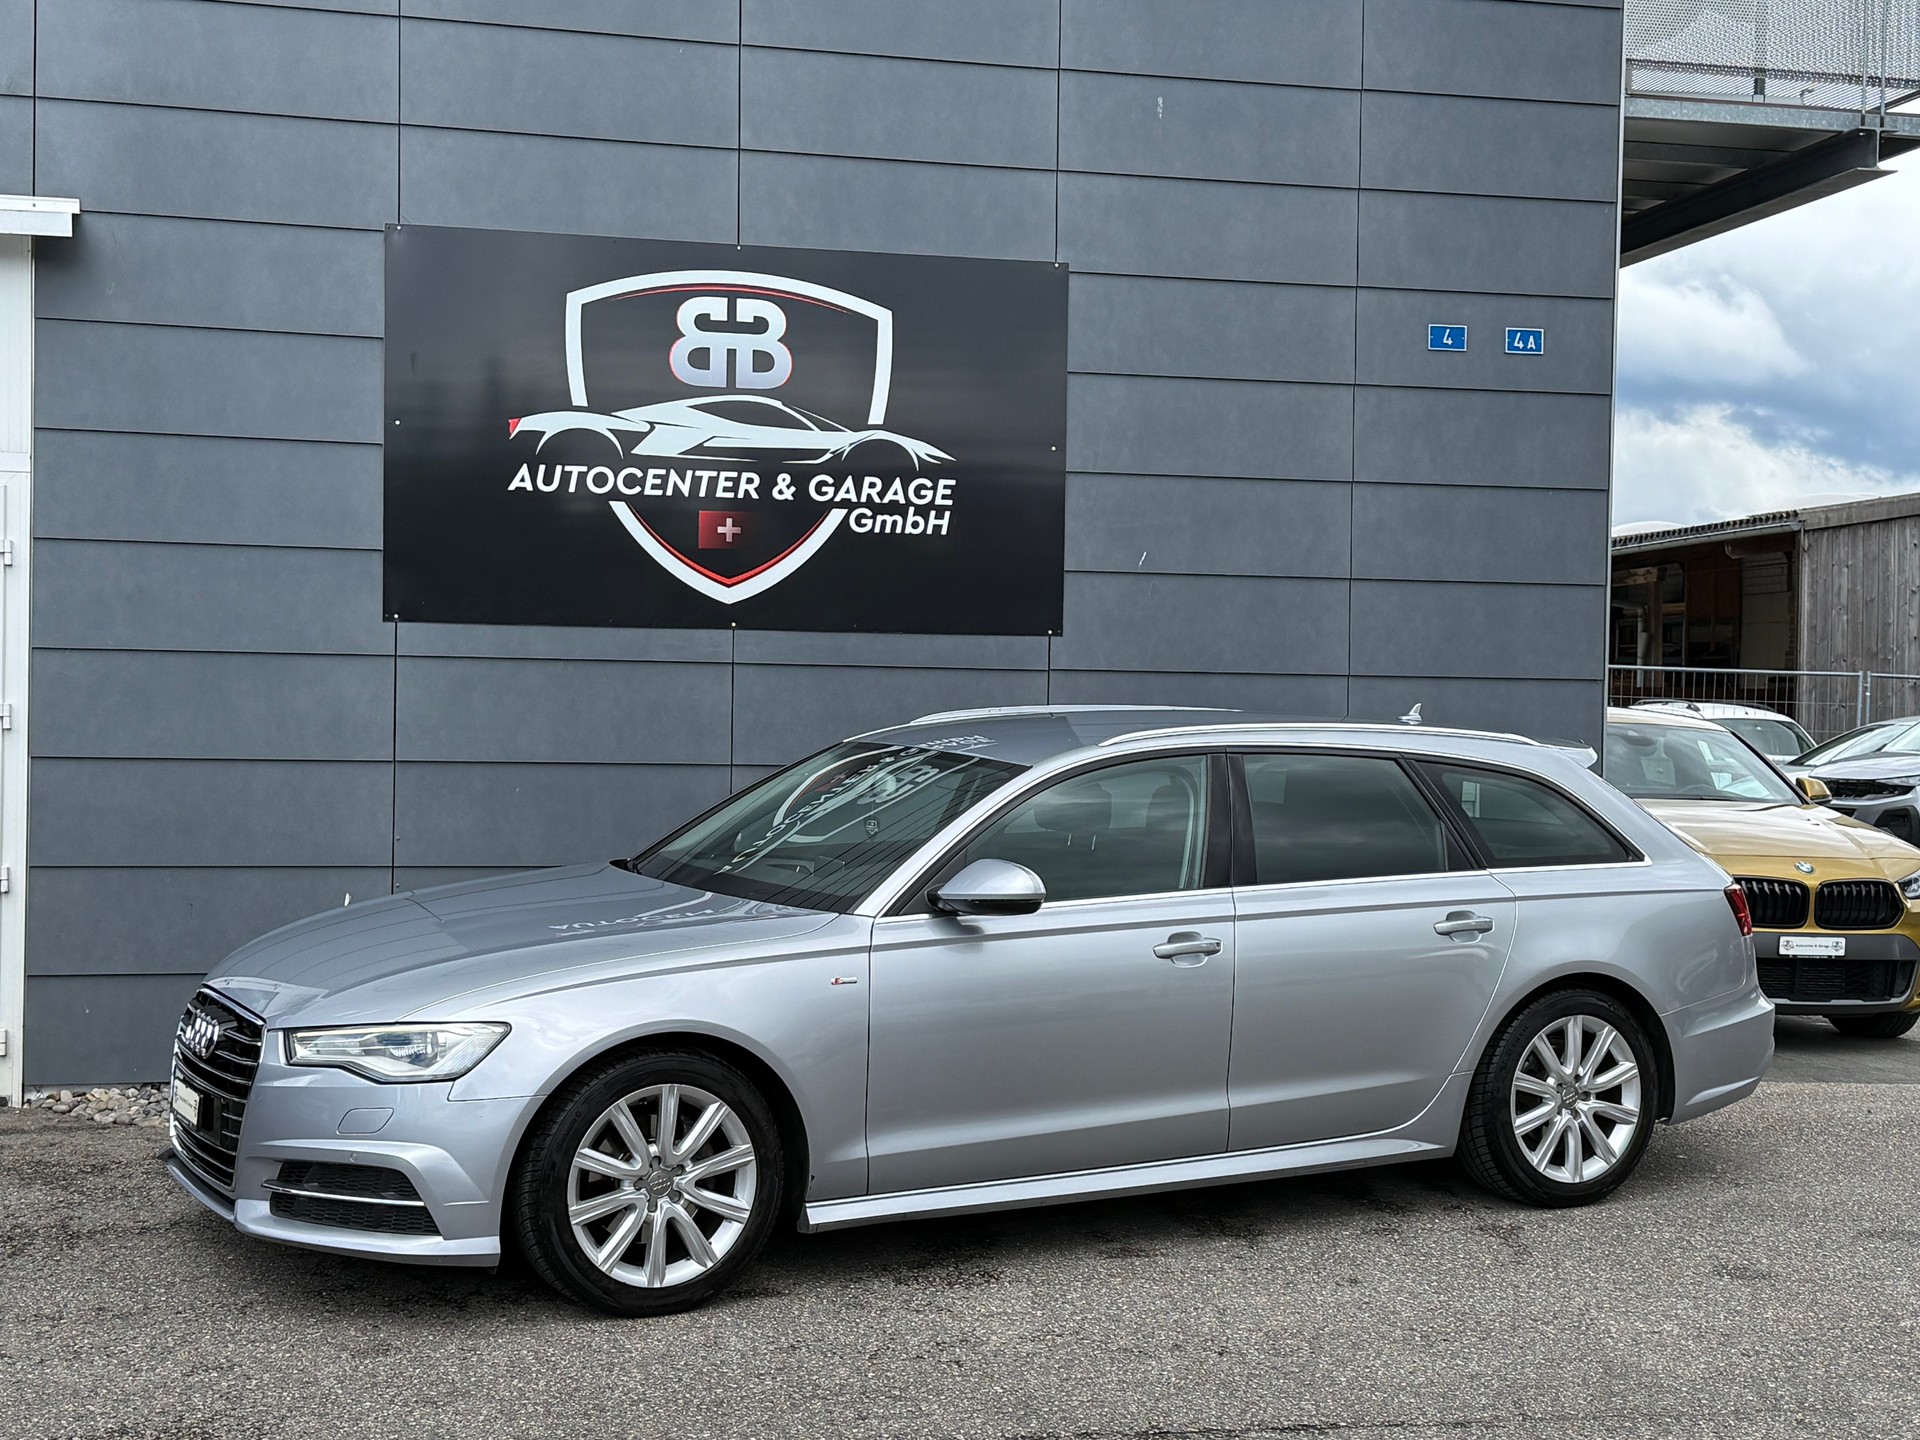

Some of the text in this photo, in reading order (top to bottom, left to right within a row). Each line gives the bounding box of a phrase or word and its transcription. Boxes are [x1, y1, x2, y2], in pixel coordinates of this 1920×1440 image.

[1443, 328, 1453, 346] 4
[507, 462, 957, 506] AUTOCENTER & GARAGE
[848, 505, 951, 536] GmbH
